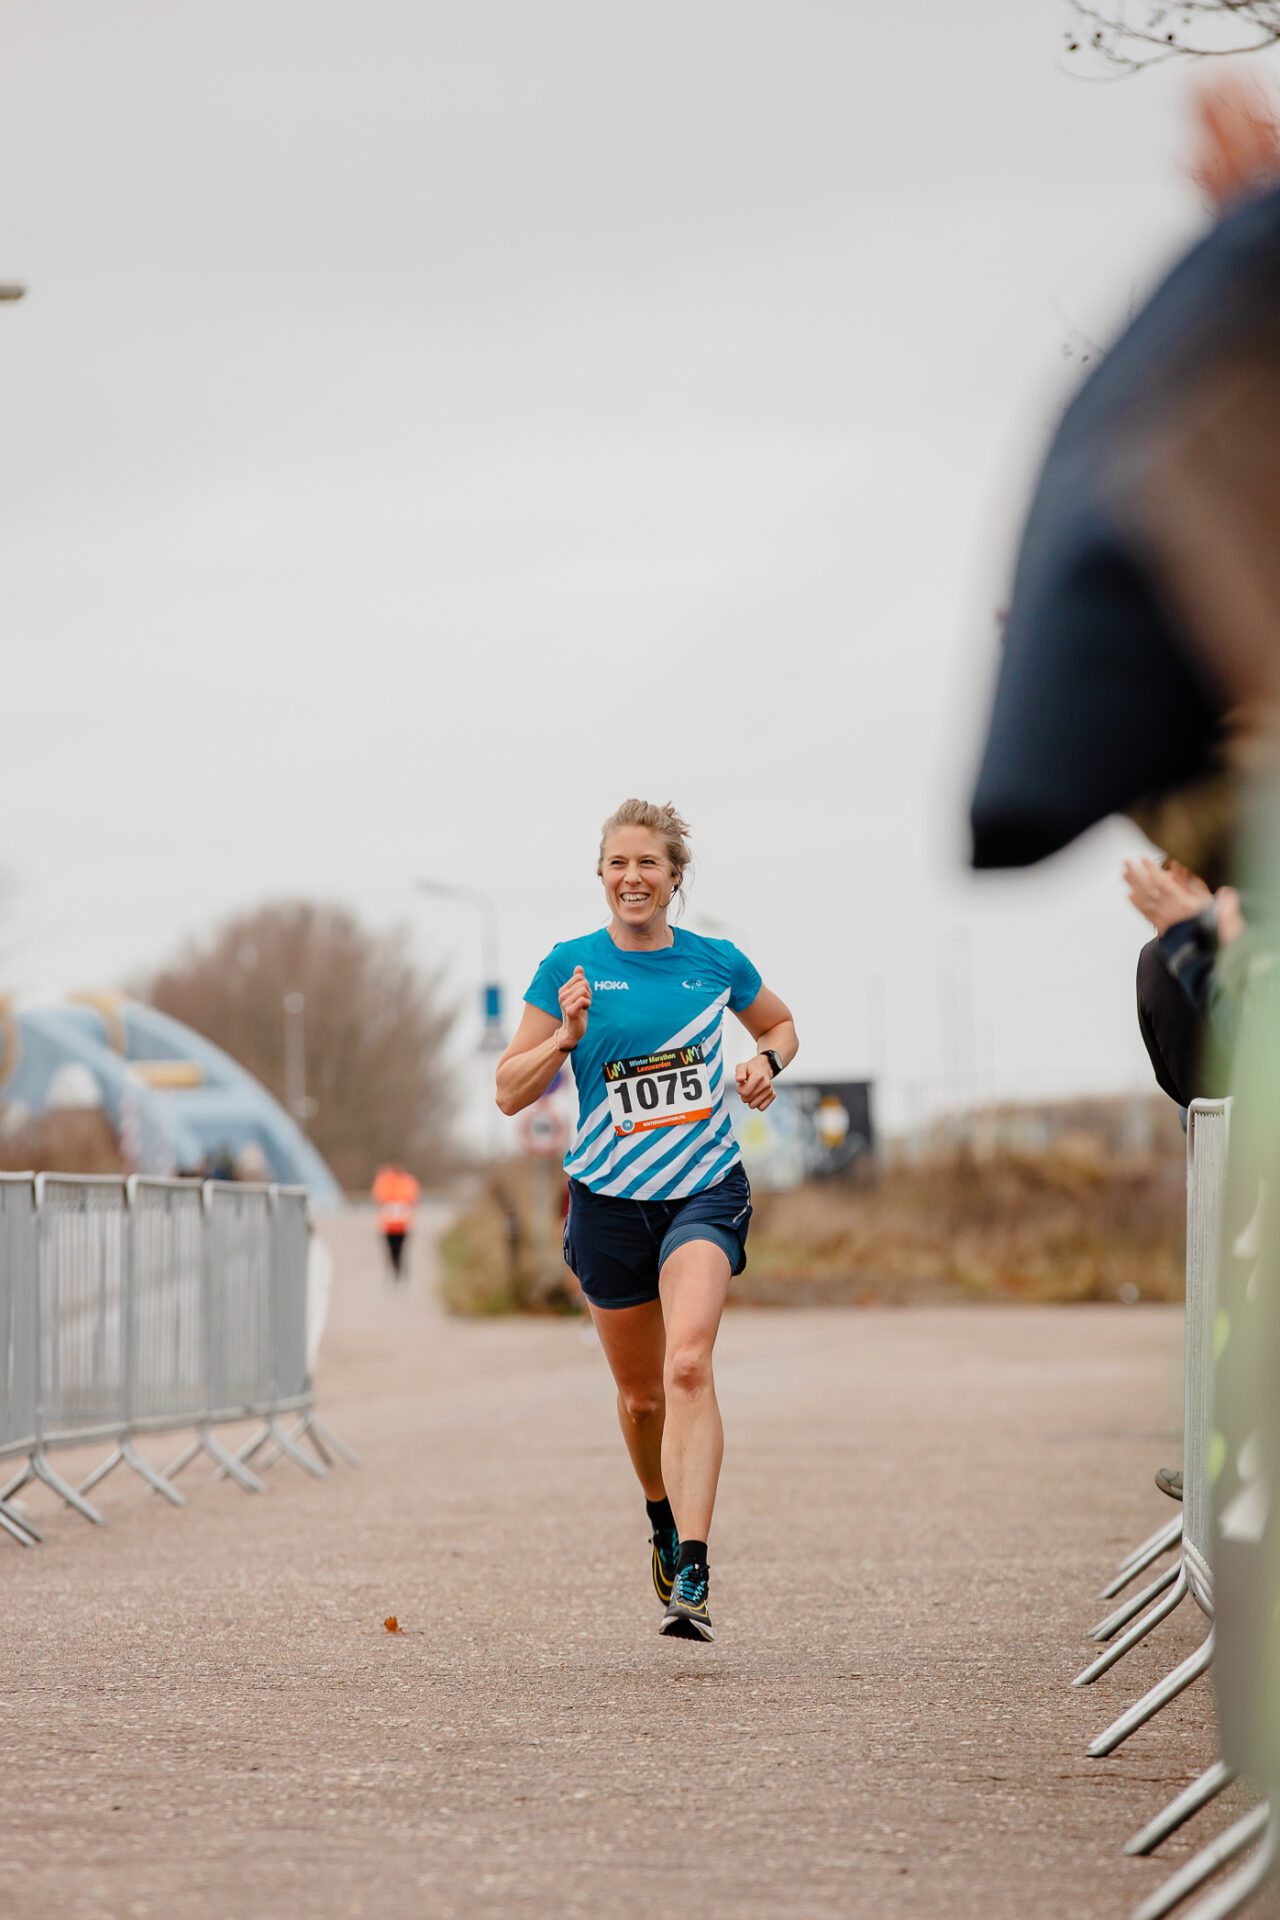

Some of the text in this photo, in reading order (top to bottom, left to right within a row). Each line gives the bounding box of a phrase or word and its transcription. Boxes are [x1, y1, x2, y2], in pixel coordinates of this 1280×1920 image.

[594, 981, 629, 991] HOKA
[629, 1053, 676, 1068] Winter Marathon
[637, 1061, 671, 1073] Leeuwarden
[614, 1068, 702, 1114] 1075
